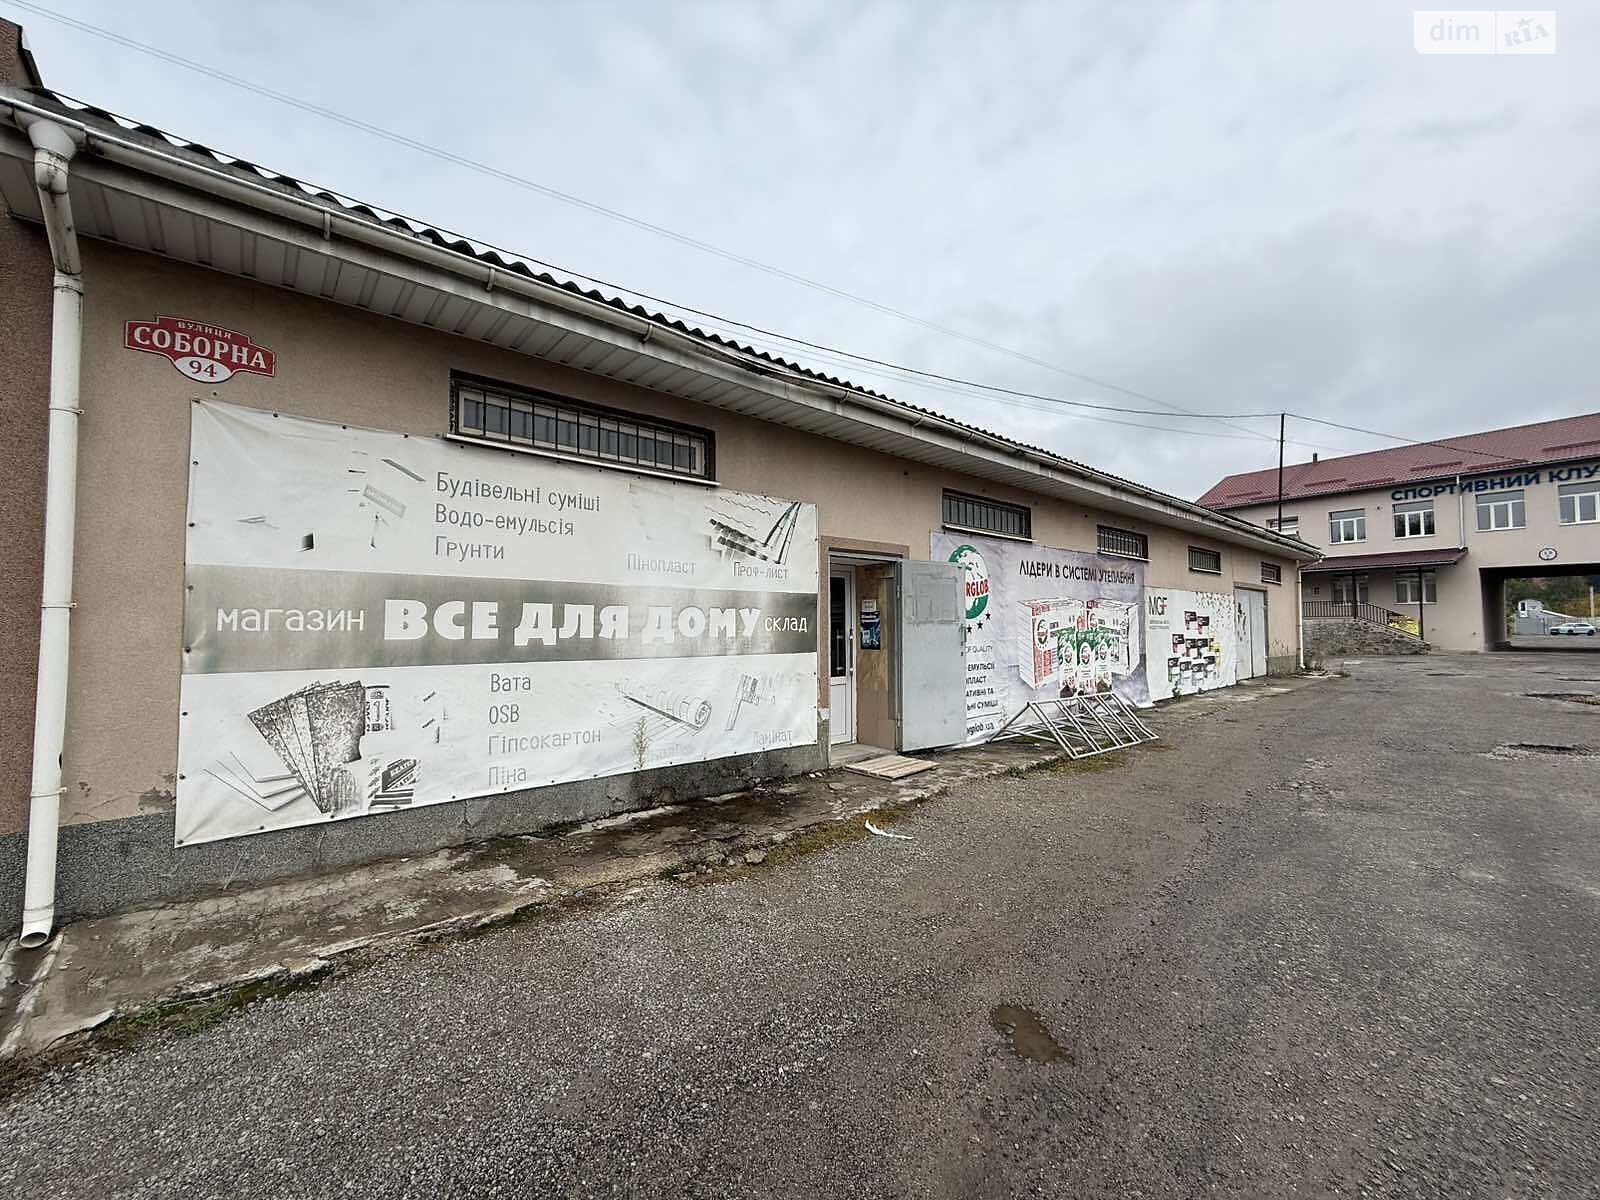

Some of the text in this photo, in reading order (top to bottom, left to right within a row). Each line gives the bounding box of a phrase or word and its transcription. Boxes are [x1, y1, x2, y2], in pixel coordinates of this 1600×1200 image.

[177, 320, 232, 340] ВУЛИЦЯ
[133, 326, 267, 369] СОБОРНА
[189, 360, 217, 378] 94
[436, 471, 541, 504] Будівельні
[548, 491, 601, 511] суміші
[1391, 464, 1600, 501] СПОРТИВНИЙ КЛУ
[435, 503, 575, 536] Водо-емульсія
[434, 535, 504, 562] Грунти
[627, 553, 696, 575] Пінопласт
[1019, 560, 1136, 585] ЛІДЕРИ В СИСТЕМІ УТЕПЛЕННЯ
[216, 598, 808, 648] магазин ВСЕ ДЛЯ ДОМУ склад
[490, 673, 532, 693] Вата
[488, 704, 521, 725] OSB
[488, 729, 602, 755] Гіпсокартон
[488, 766, 528, 786] Піна
